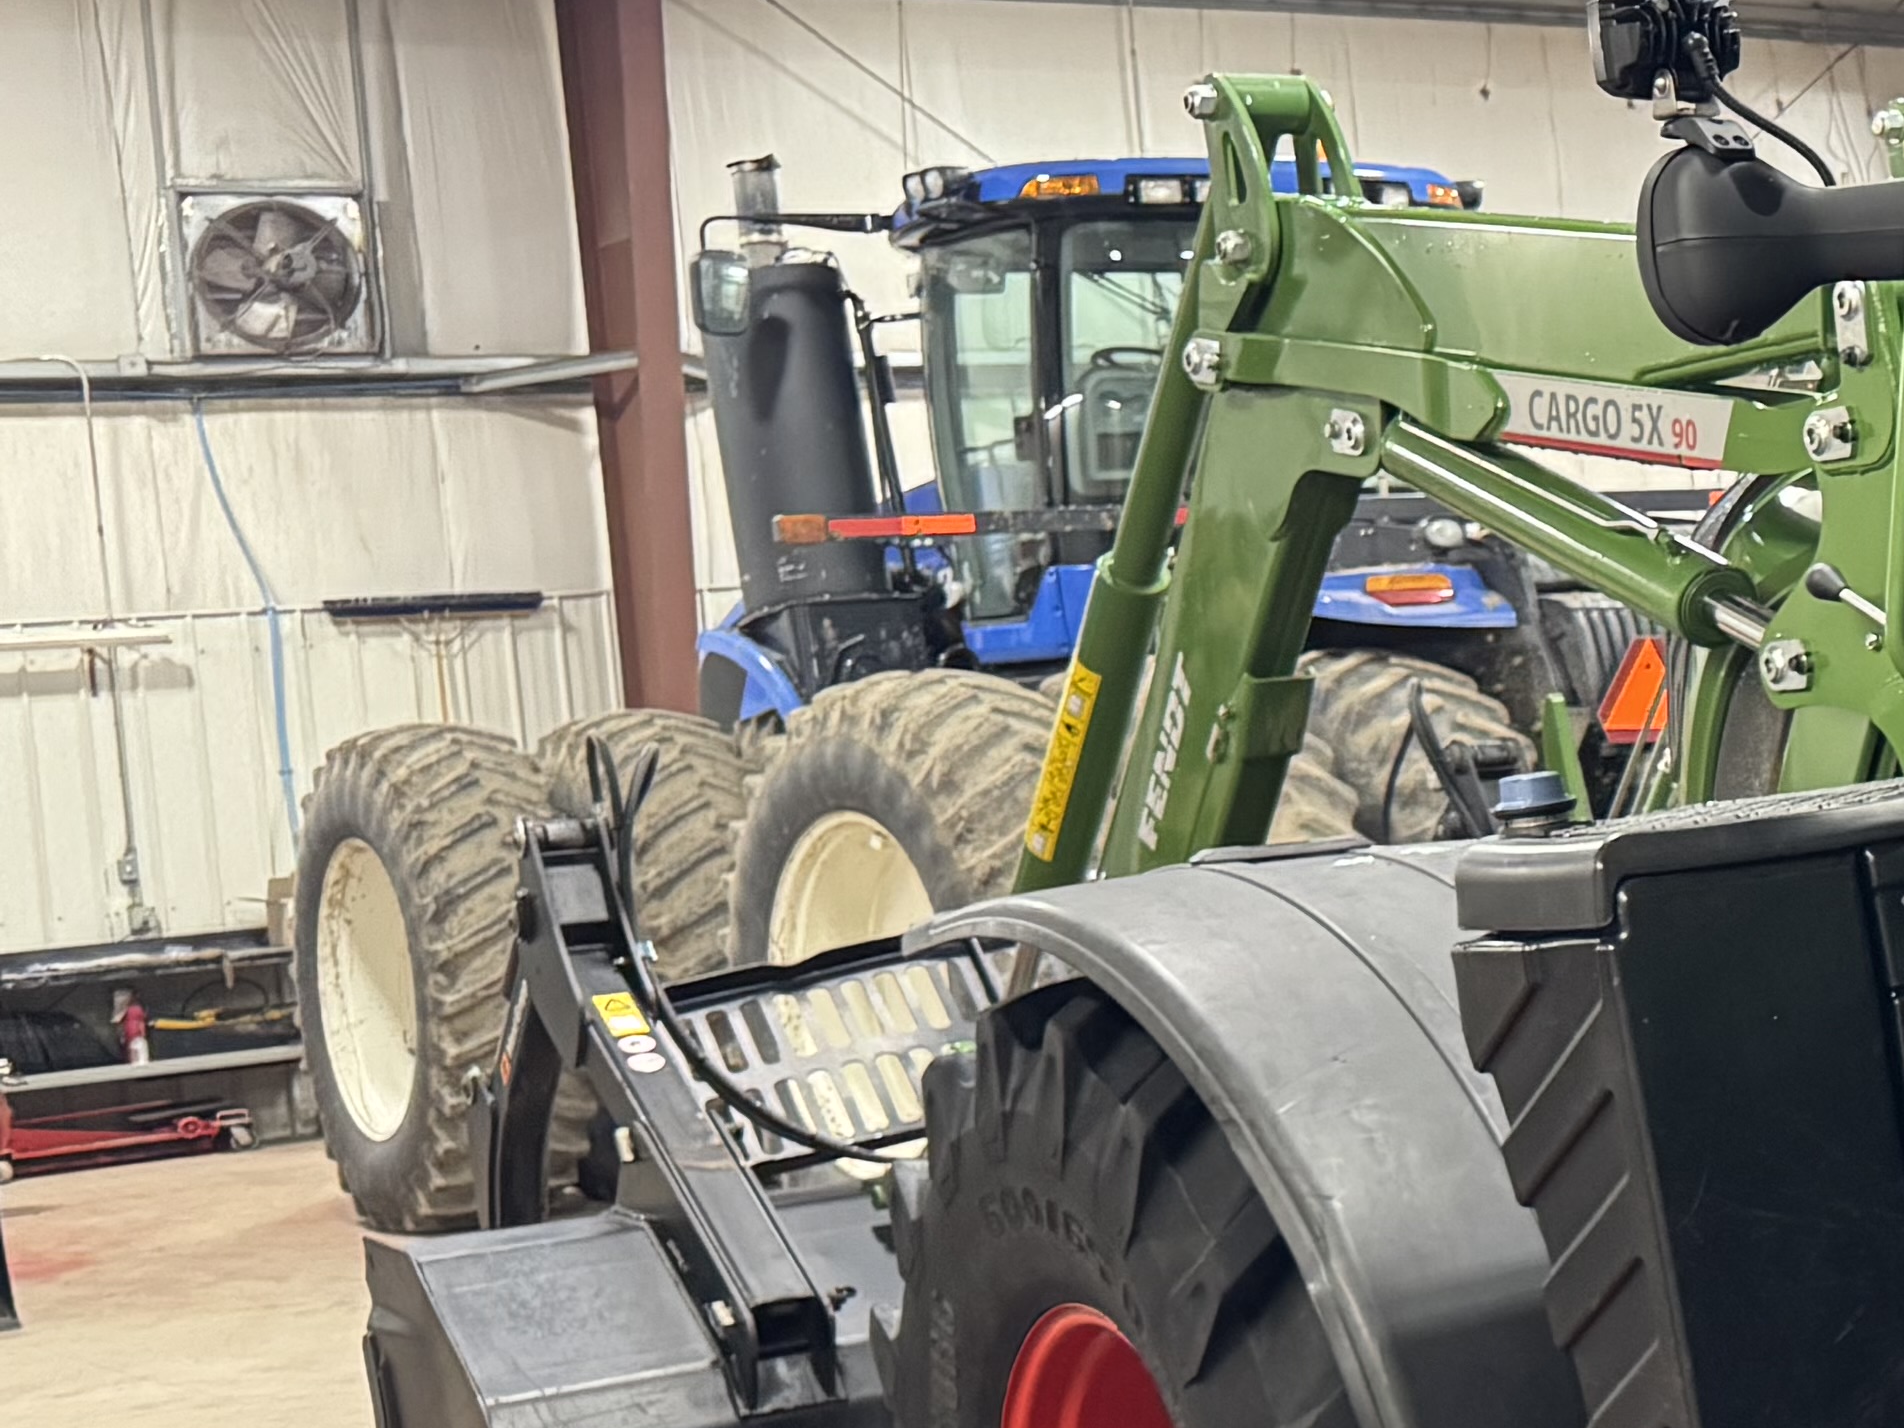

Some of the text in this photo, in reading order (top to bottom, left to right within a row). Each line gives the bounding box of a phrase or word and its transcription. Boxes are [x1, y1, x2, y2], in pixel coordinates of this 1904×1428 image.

[1528, 388, 1698, 452] CARGO 5X 90
[1138, 650, 1192, 852] FENDT
